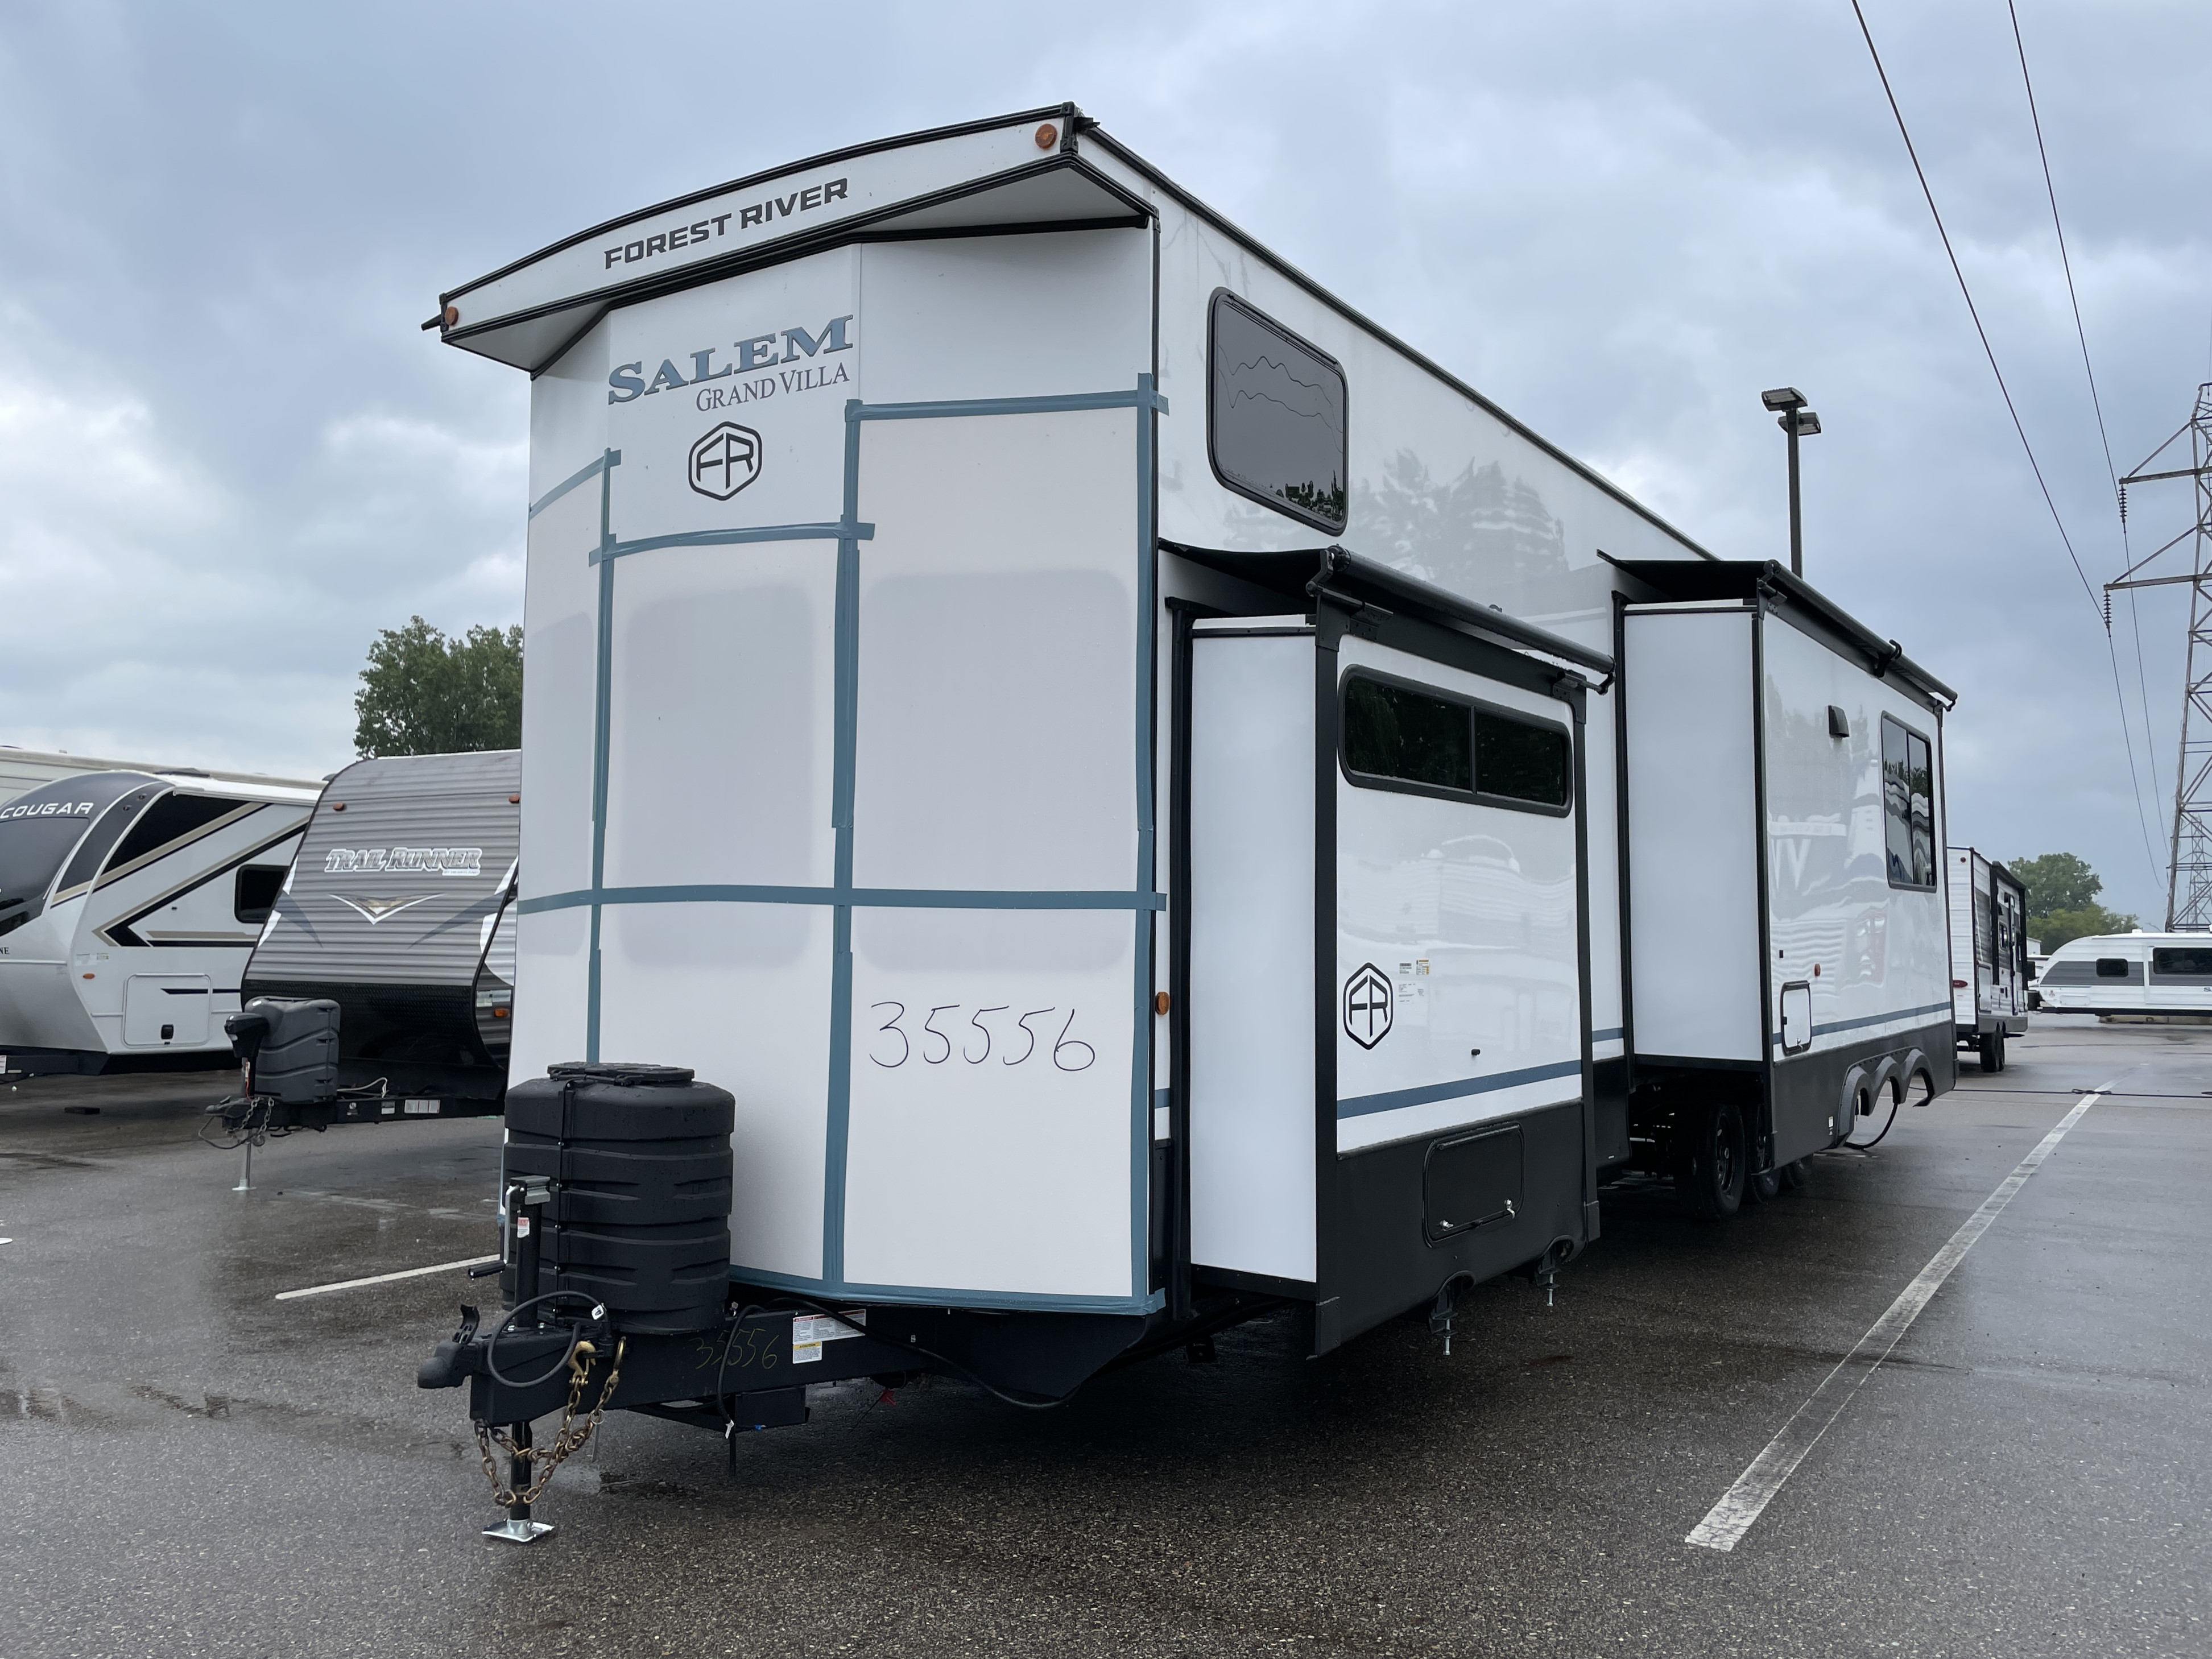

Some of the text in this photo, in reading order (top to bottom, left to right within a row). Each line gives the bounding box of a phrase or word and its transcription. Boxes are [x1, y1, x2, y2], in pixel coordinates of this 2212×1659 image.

[604, 177, 849, 270] FOREST RIVER
[608, 314, 853, 406] SALEM
[696, 362, 850, 412] GRAND VILLA
[0, 802, 94, 819] COUGAR
[324, 847, 482, 872] TRAIL RUNNER
[869, 1001, 1095, 1071] 35556
